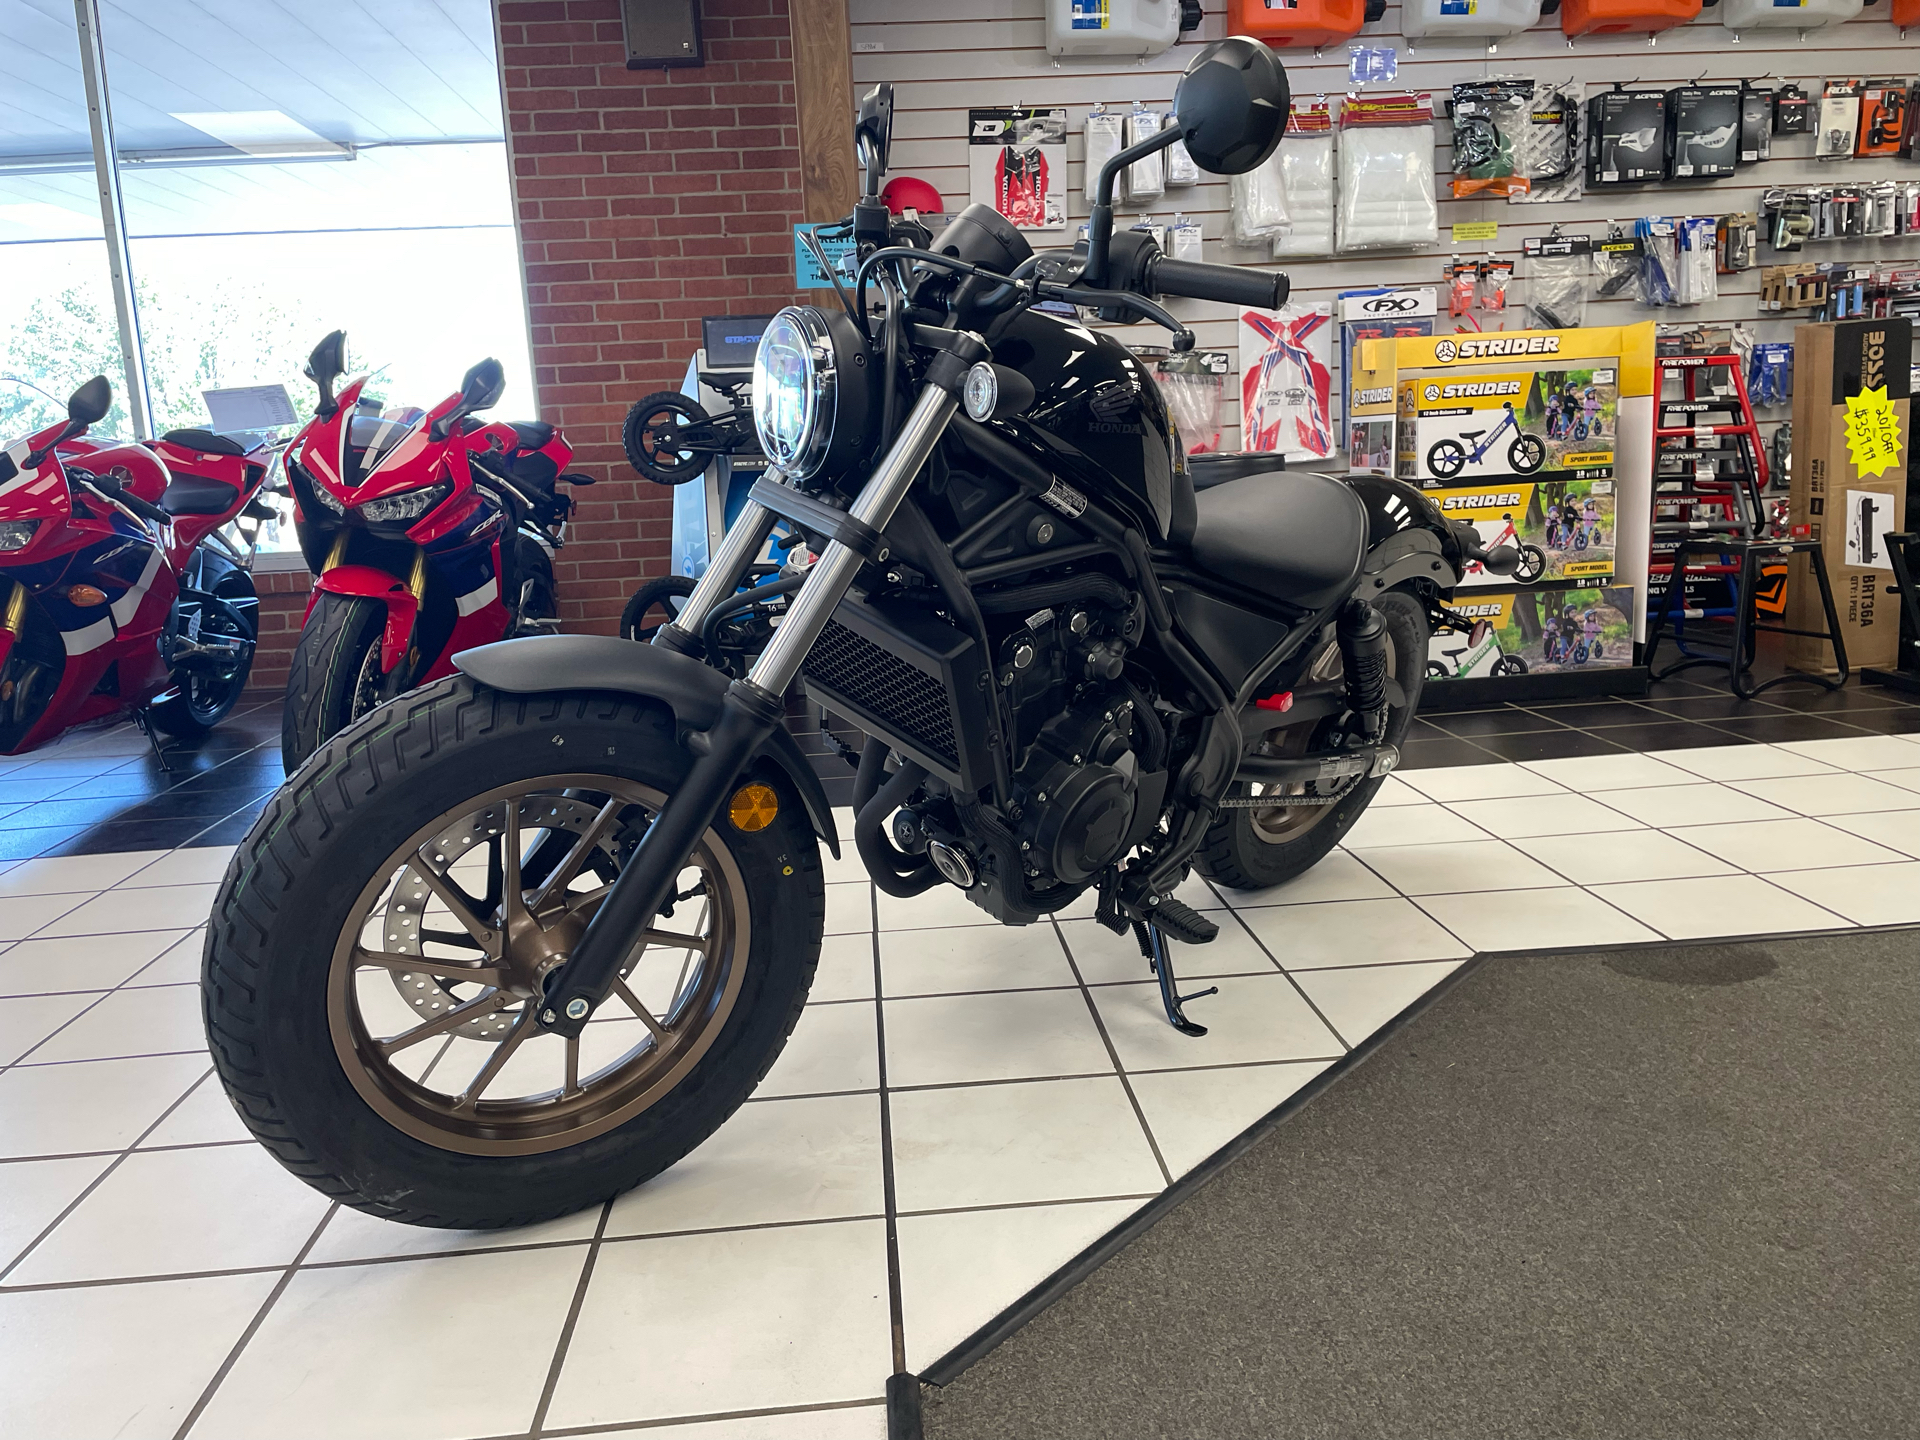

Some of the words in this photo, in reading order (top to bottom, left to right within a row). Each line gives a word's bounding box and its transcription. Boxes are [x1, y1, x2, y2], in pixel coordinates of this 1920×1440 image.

[1531, 111, 1562, 120] maier
[1457, 335, 1561, 358] STRIDER
[1678, 358, 1705, 366] POWER
[1867, 330, 1886, 388] BOSS
[1359, 386, 1393, 405] STRIDER
[1442, 380, 1521, 398] STRIDER
[1088, 422, 1140, 434] HONDA
[1483, 421, 1508, 448] STRIDER
[1570, 455, 1588, 463] SPORT
[1589, 454, 1608, 462] MODEL
[1811, 459, 1819, 492] BRT36A
[1442, 493, 1521, 510] STRIDER
[1570, 564, 1588, 572] SPORT
[1589, 563, 1608, 571] MODEL
[1849, 575, 1859, 594] QTY:
[1446, 603, 1502, 618] RIDER
[1860, 574, 1876, 628] BRT36A
[1849, 601, 1858, 623] PIECE
[1467, 643, 1491, 669] STRIDER
